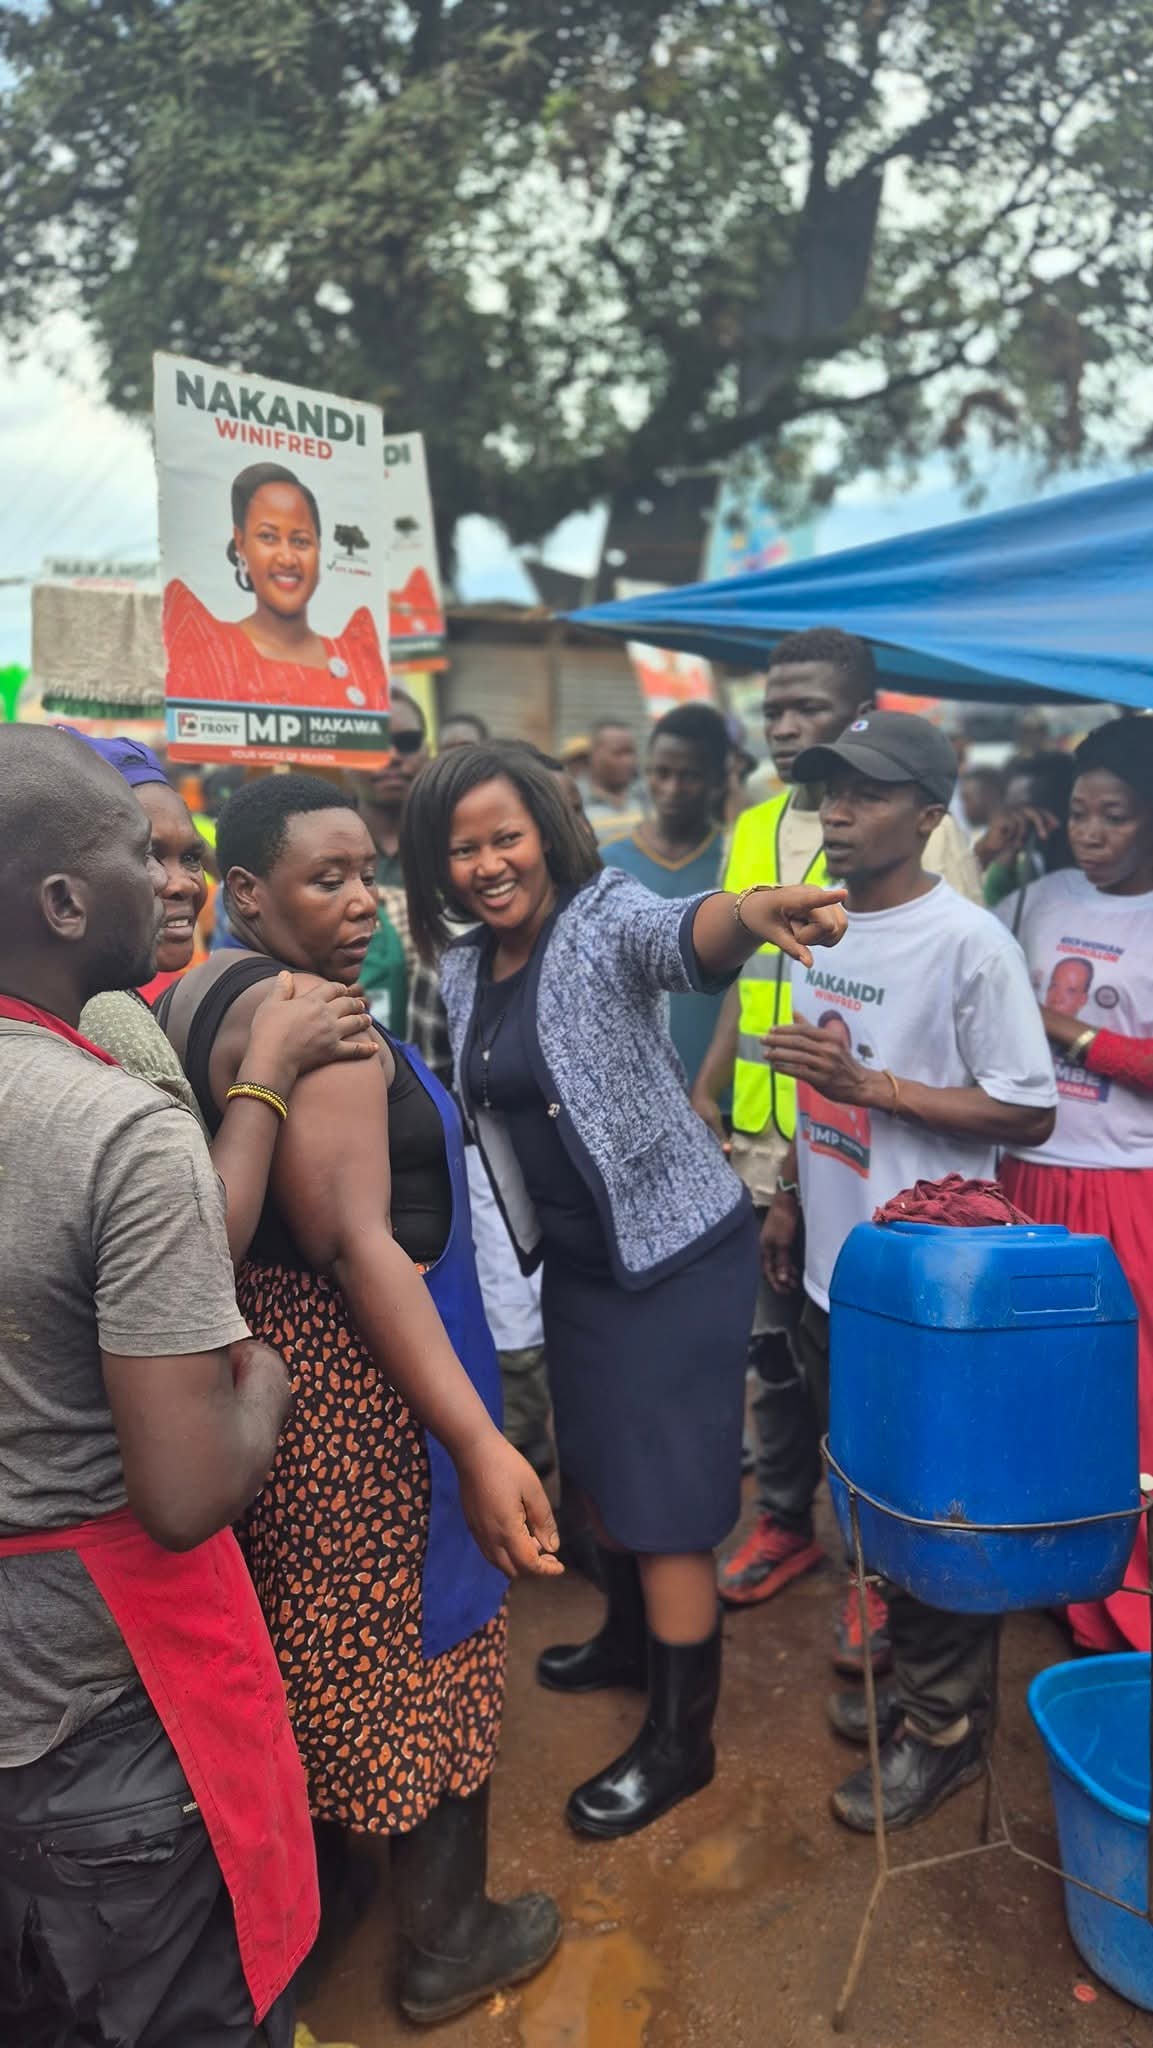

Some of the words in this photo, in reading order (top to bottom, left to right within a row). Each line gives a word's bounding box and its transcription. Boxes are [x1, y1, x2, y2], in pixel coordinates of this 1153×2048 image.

[175, 370, 366, 446] NAKANDI
[214, 417, 333, 460] WINIFRED
[200, 721, 239, 735] FRONT
[249, 712, 301, 744] MP
[309, 716, 382, 735] NAKAWA
[310, 733, 338, 745] EAST
[231, 749, 257, 760] YOUR
[259, 751, 285, 761] VOICE
[805, 968, 885, 1006] NAKANDI
[1055, 1063, 1102, 1087] MBE
[815, 1126, 840, 1146] MP
